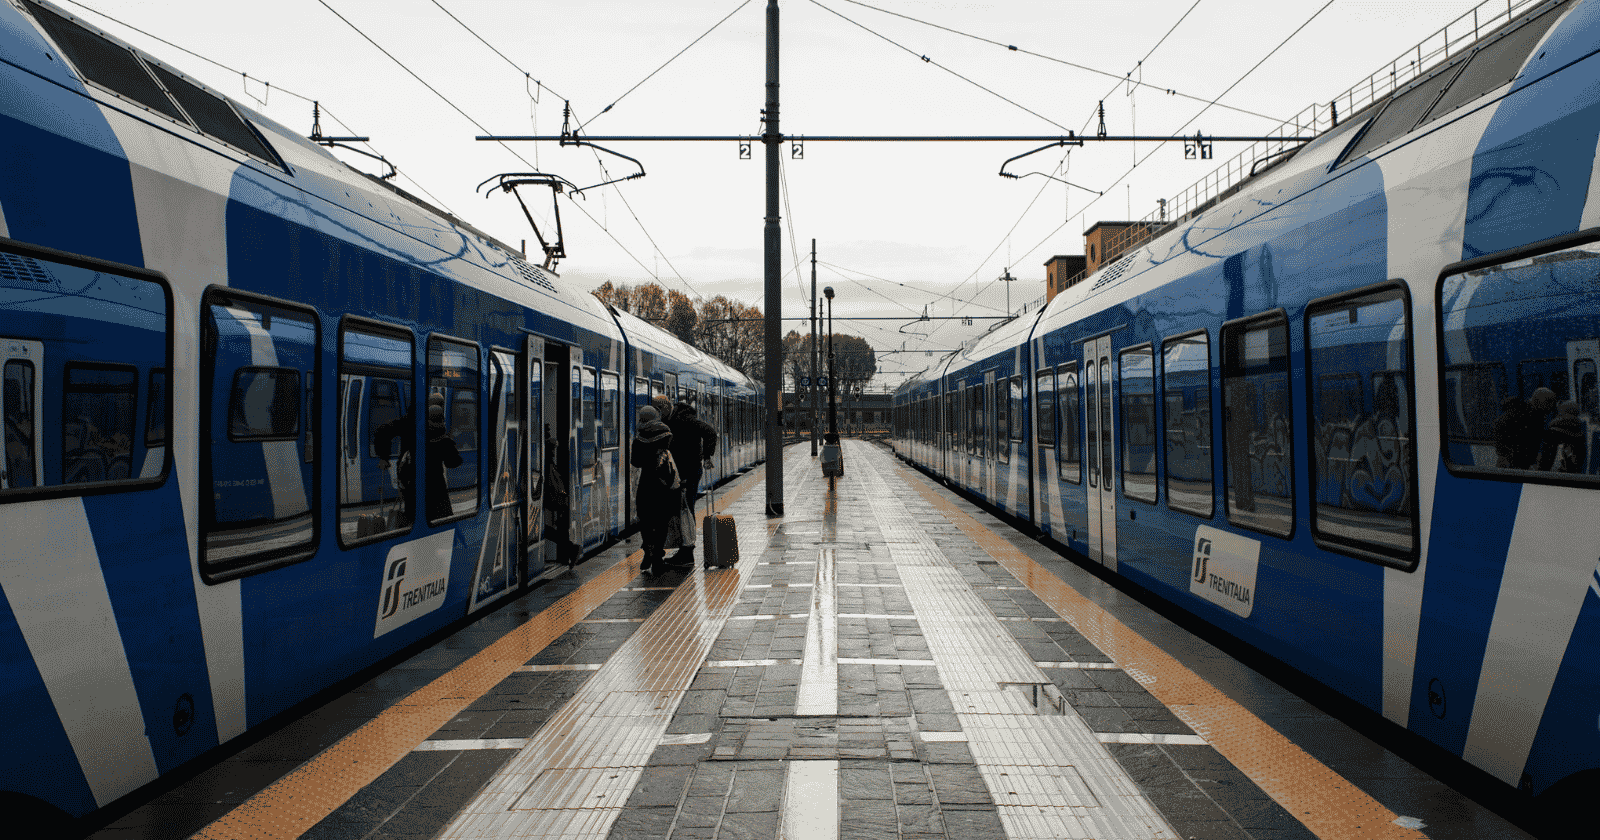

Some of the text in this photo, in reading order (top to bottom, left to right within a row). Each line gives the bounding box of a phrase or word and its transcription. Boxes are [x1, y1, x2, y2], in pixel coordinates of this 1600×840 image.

[740, 144, 751, 159] 2
[792, 144, 803, 159] 2
[1185, 145, 1196, 159] 2
[1202, 145, 1211, 159] 1
[402, 577, 446, 610] TRENITALIA
[1209, 573, 1250, 605] TRENITALIA
